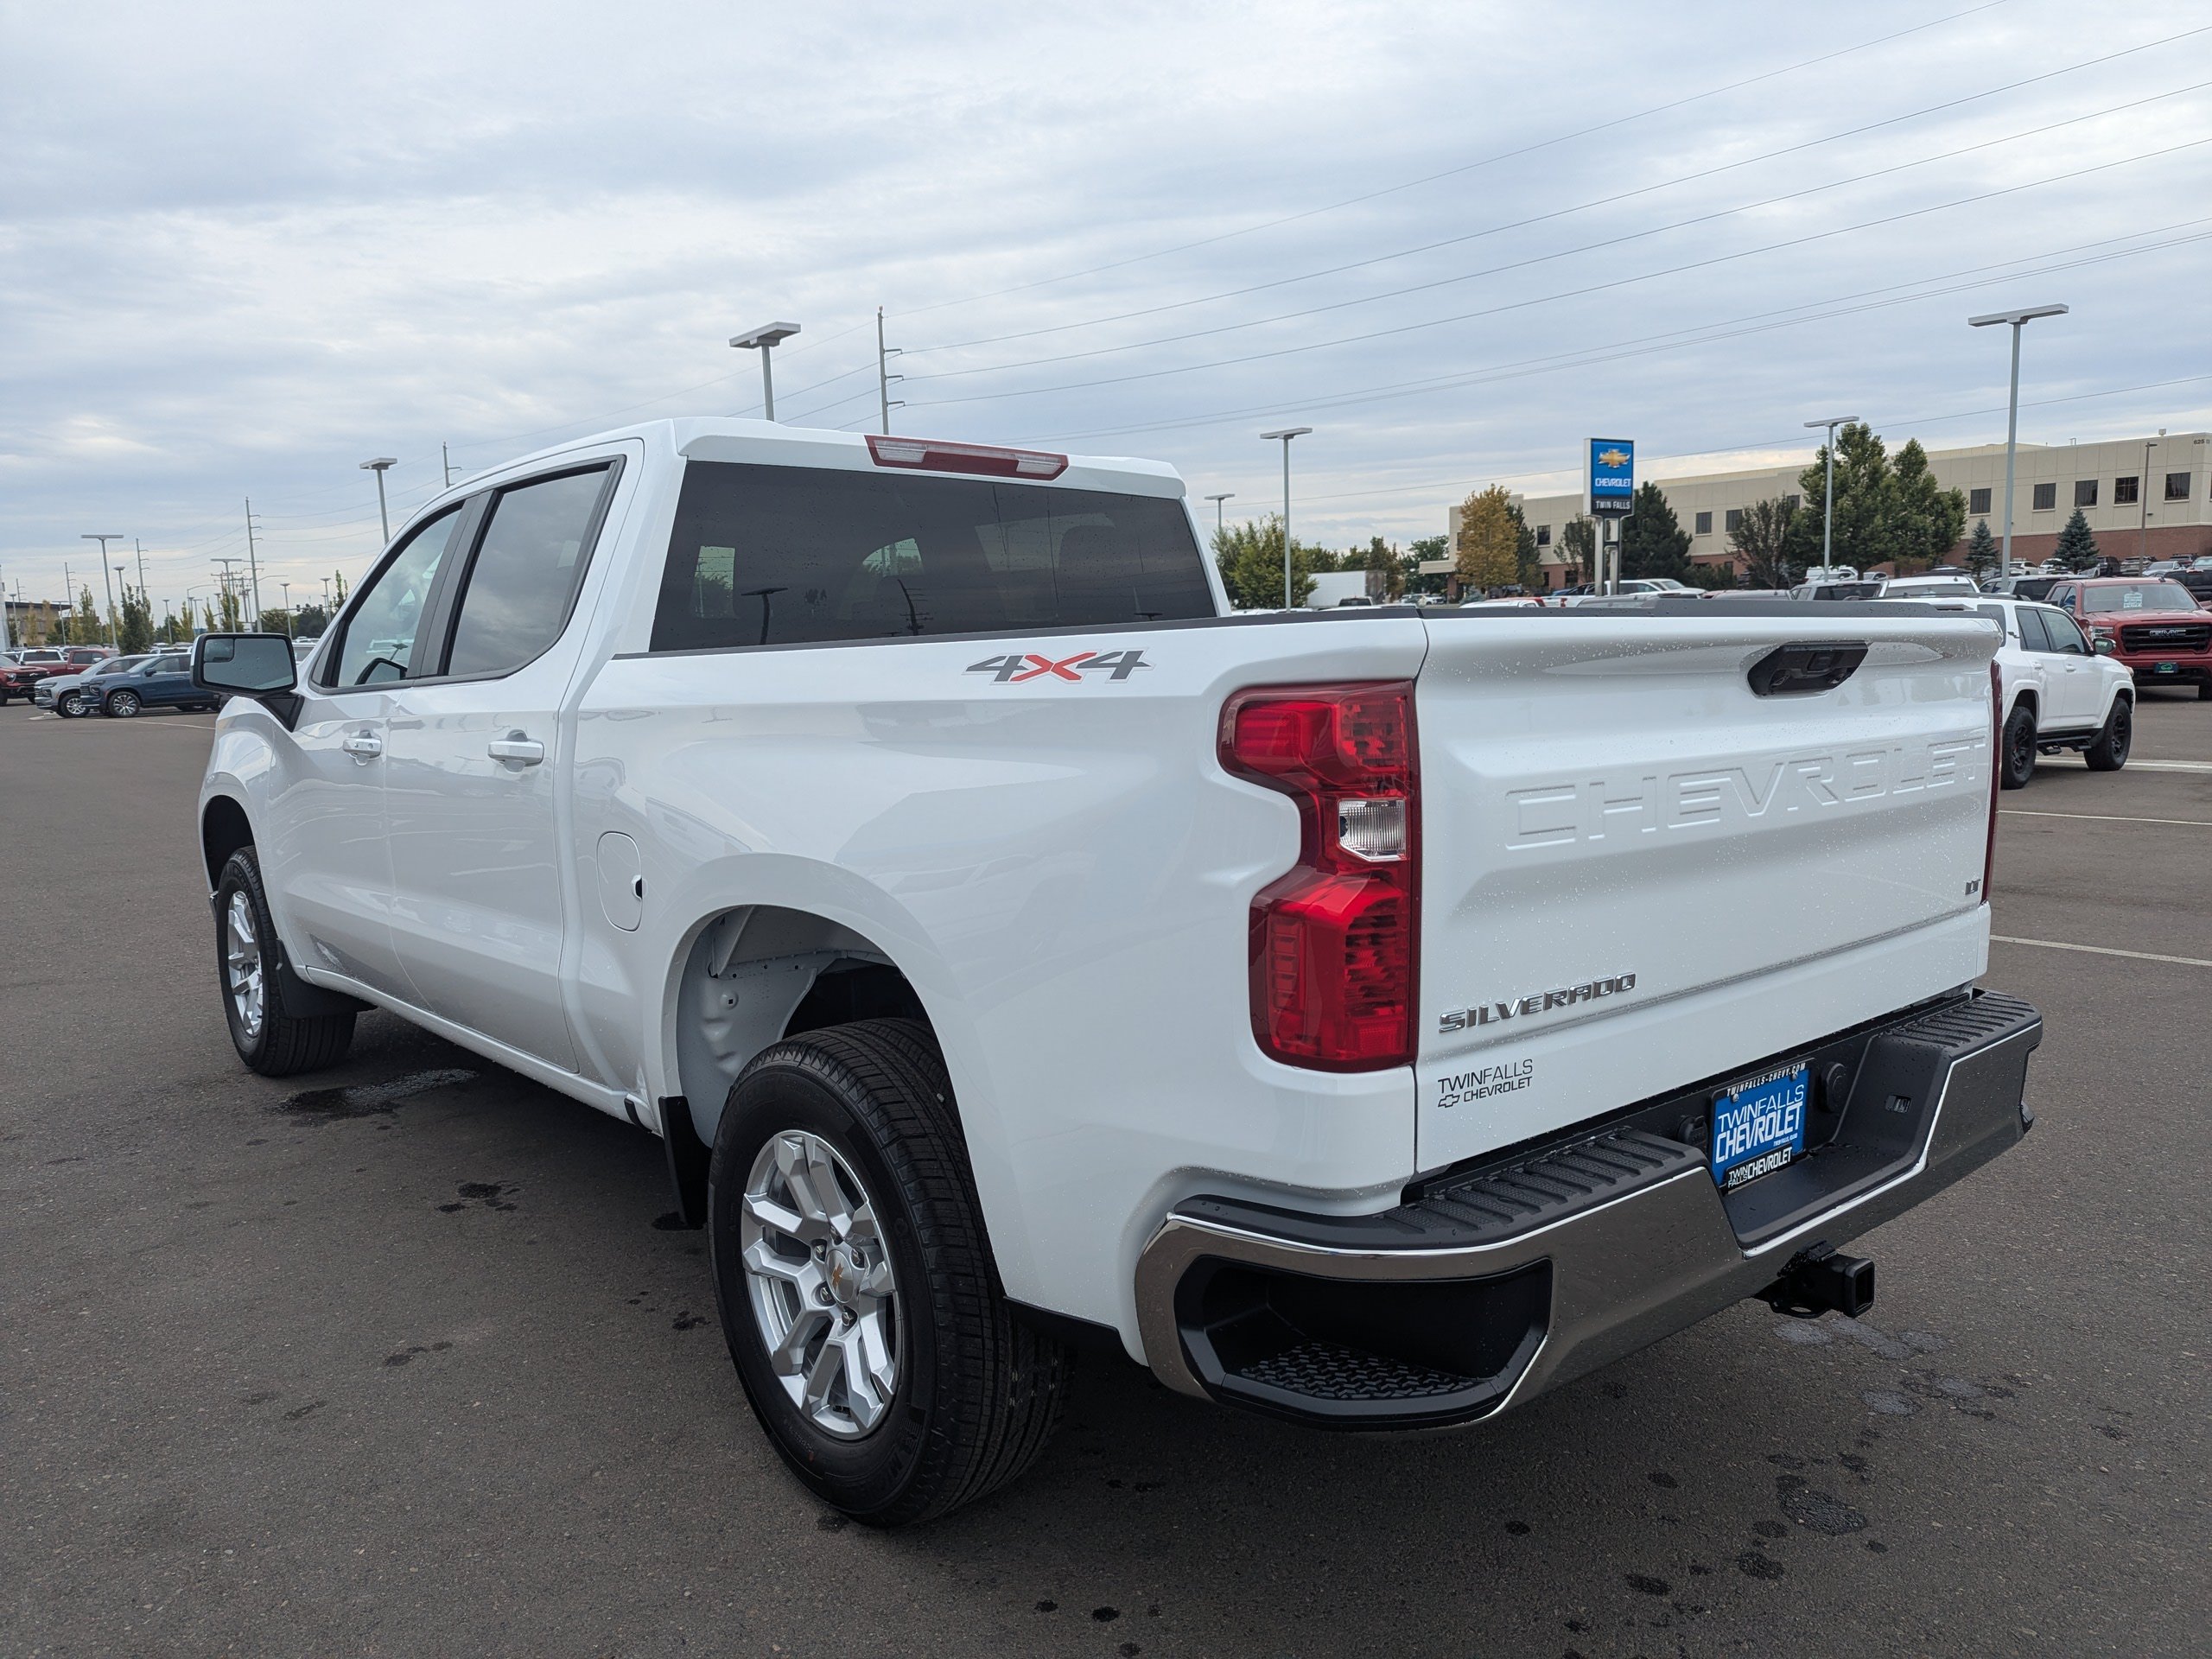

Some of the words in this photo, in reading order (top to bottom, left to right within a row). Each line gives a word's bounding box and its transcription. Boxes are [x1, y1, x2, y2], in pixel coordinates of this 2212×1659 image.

[1594, 478, 1631, 487] CHEVROLET
[1595, 500, 1611, 509] TWIN
[1612, 501, 1631, 510] FALLS
[1505, 735, 1986, 849] CHEVROLET
[1964, 879, 1981, 895] LT
[1439, 971, 1637, 1033] SILVERADO
[1437, 1058, 1533, 1094] TWINFALLS
[1463, 1076, 1533, 1103] CHEVROLET
[1726, 1062, 1806, 1096] TWINFALLS-CHEVY.COM
[1718, 1084, 1805, 1132] TWINFALLS
[1715, 1101, 1803, 1164] CHEVROLET
[1729, 1166, 1748, 1180] TWIN
[1747, 1147, 1793, 1179] CHEVROLET
[1728, 1173, 1748, 1188] FALLS
